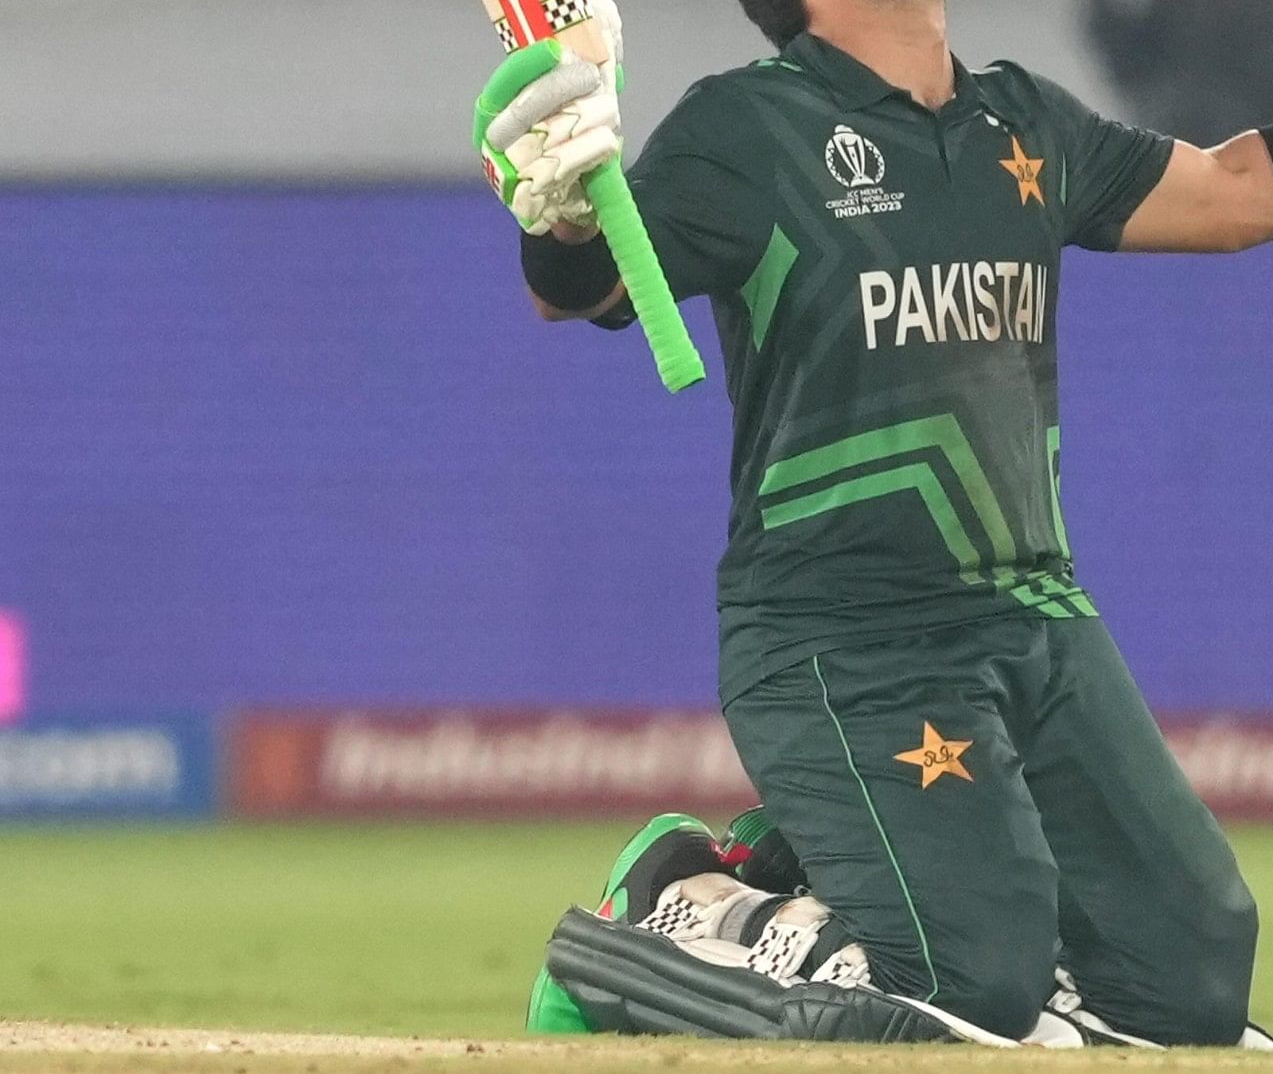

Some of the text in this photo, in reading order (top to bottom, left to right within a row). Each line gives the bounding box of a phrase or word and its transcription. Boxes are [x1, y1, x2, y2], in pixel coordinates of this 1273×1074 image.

[861, 193, 890, 205] WORLD
[890, 192, 905, 201] CUP
[834, 200, 902, 219] INDIA 2023
[859, 260, 1048, 351] PAKISTAN
